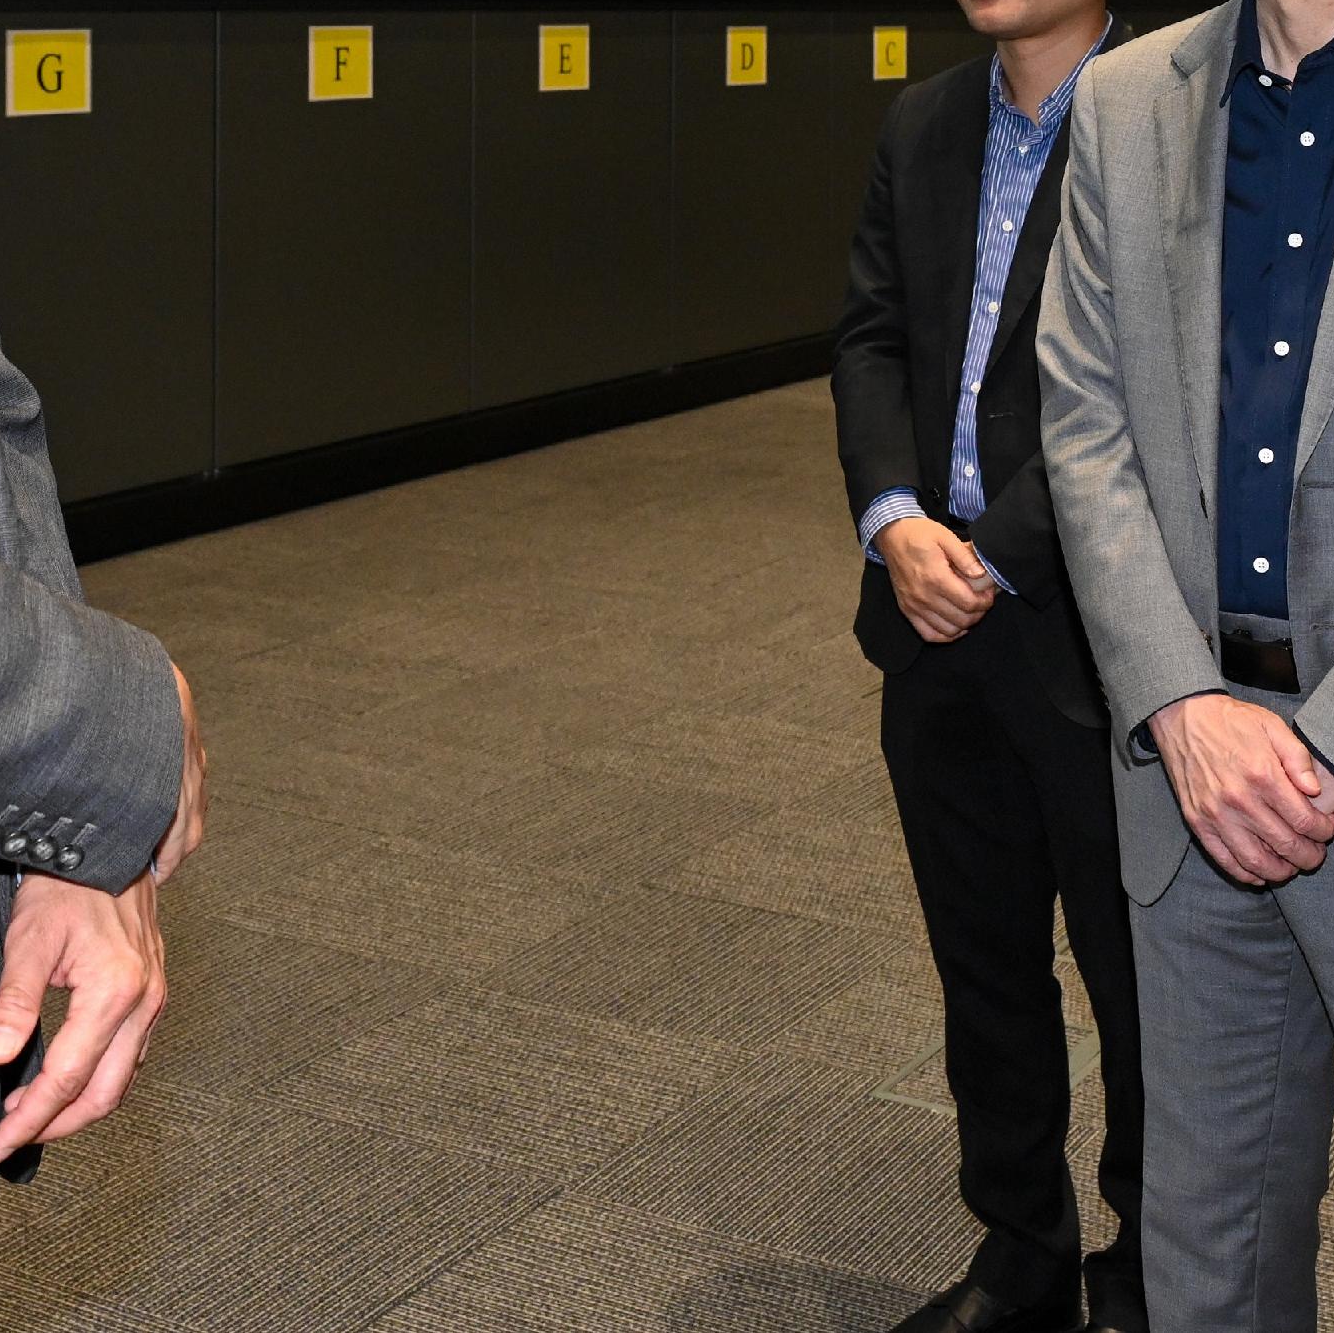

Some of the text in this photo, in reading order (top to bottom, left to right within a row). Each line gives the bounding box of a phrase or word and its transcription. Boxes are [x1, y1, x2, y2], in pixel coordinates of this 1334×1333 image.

[334, 47, 350, 81] F
[559, 44, 572, 75] E
[740, 43, 755, 71] D
[884, 40, 897, 67] C
[36, 53, 64, 94] G
